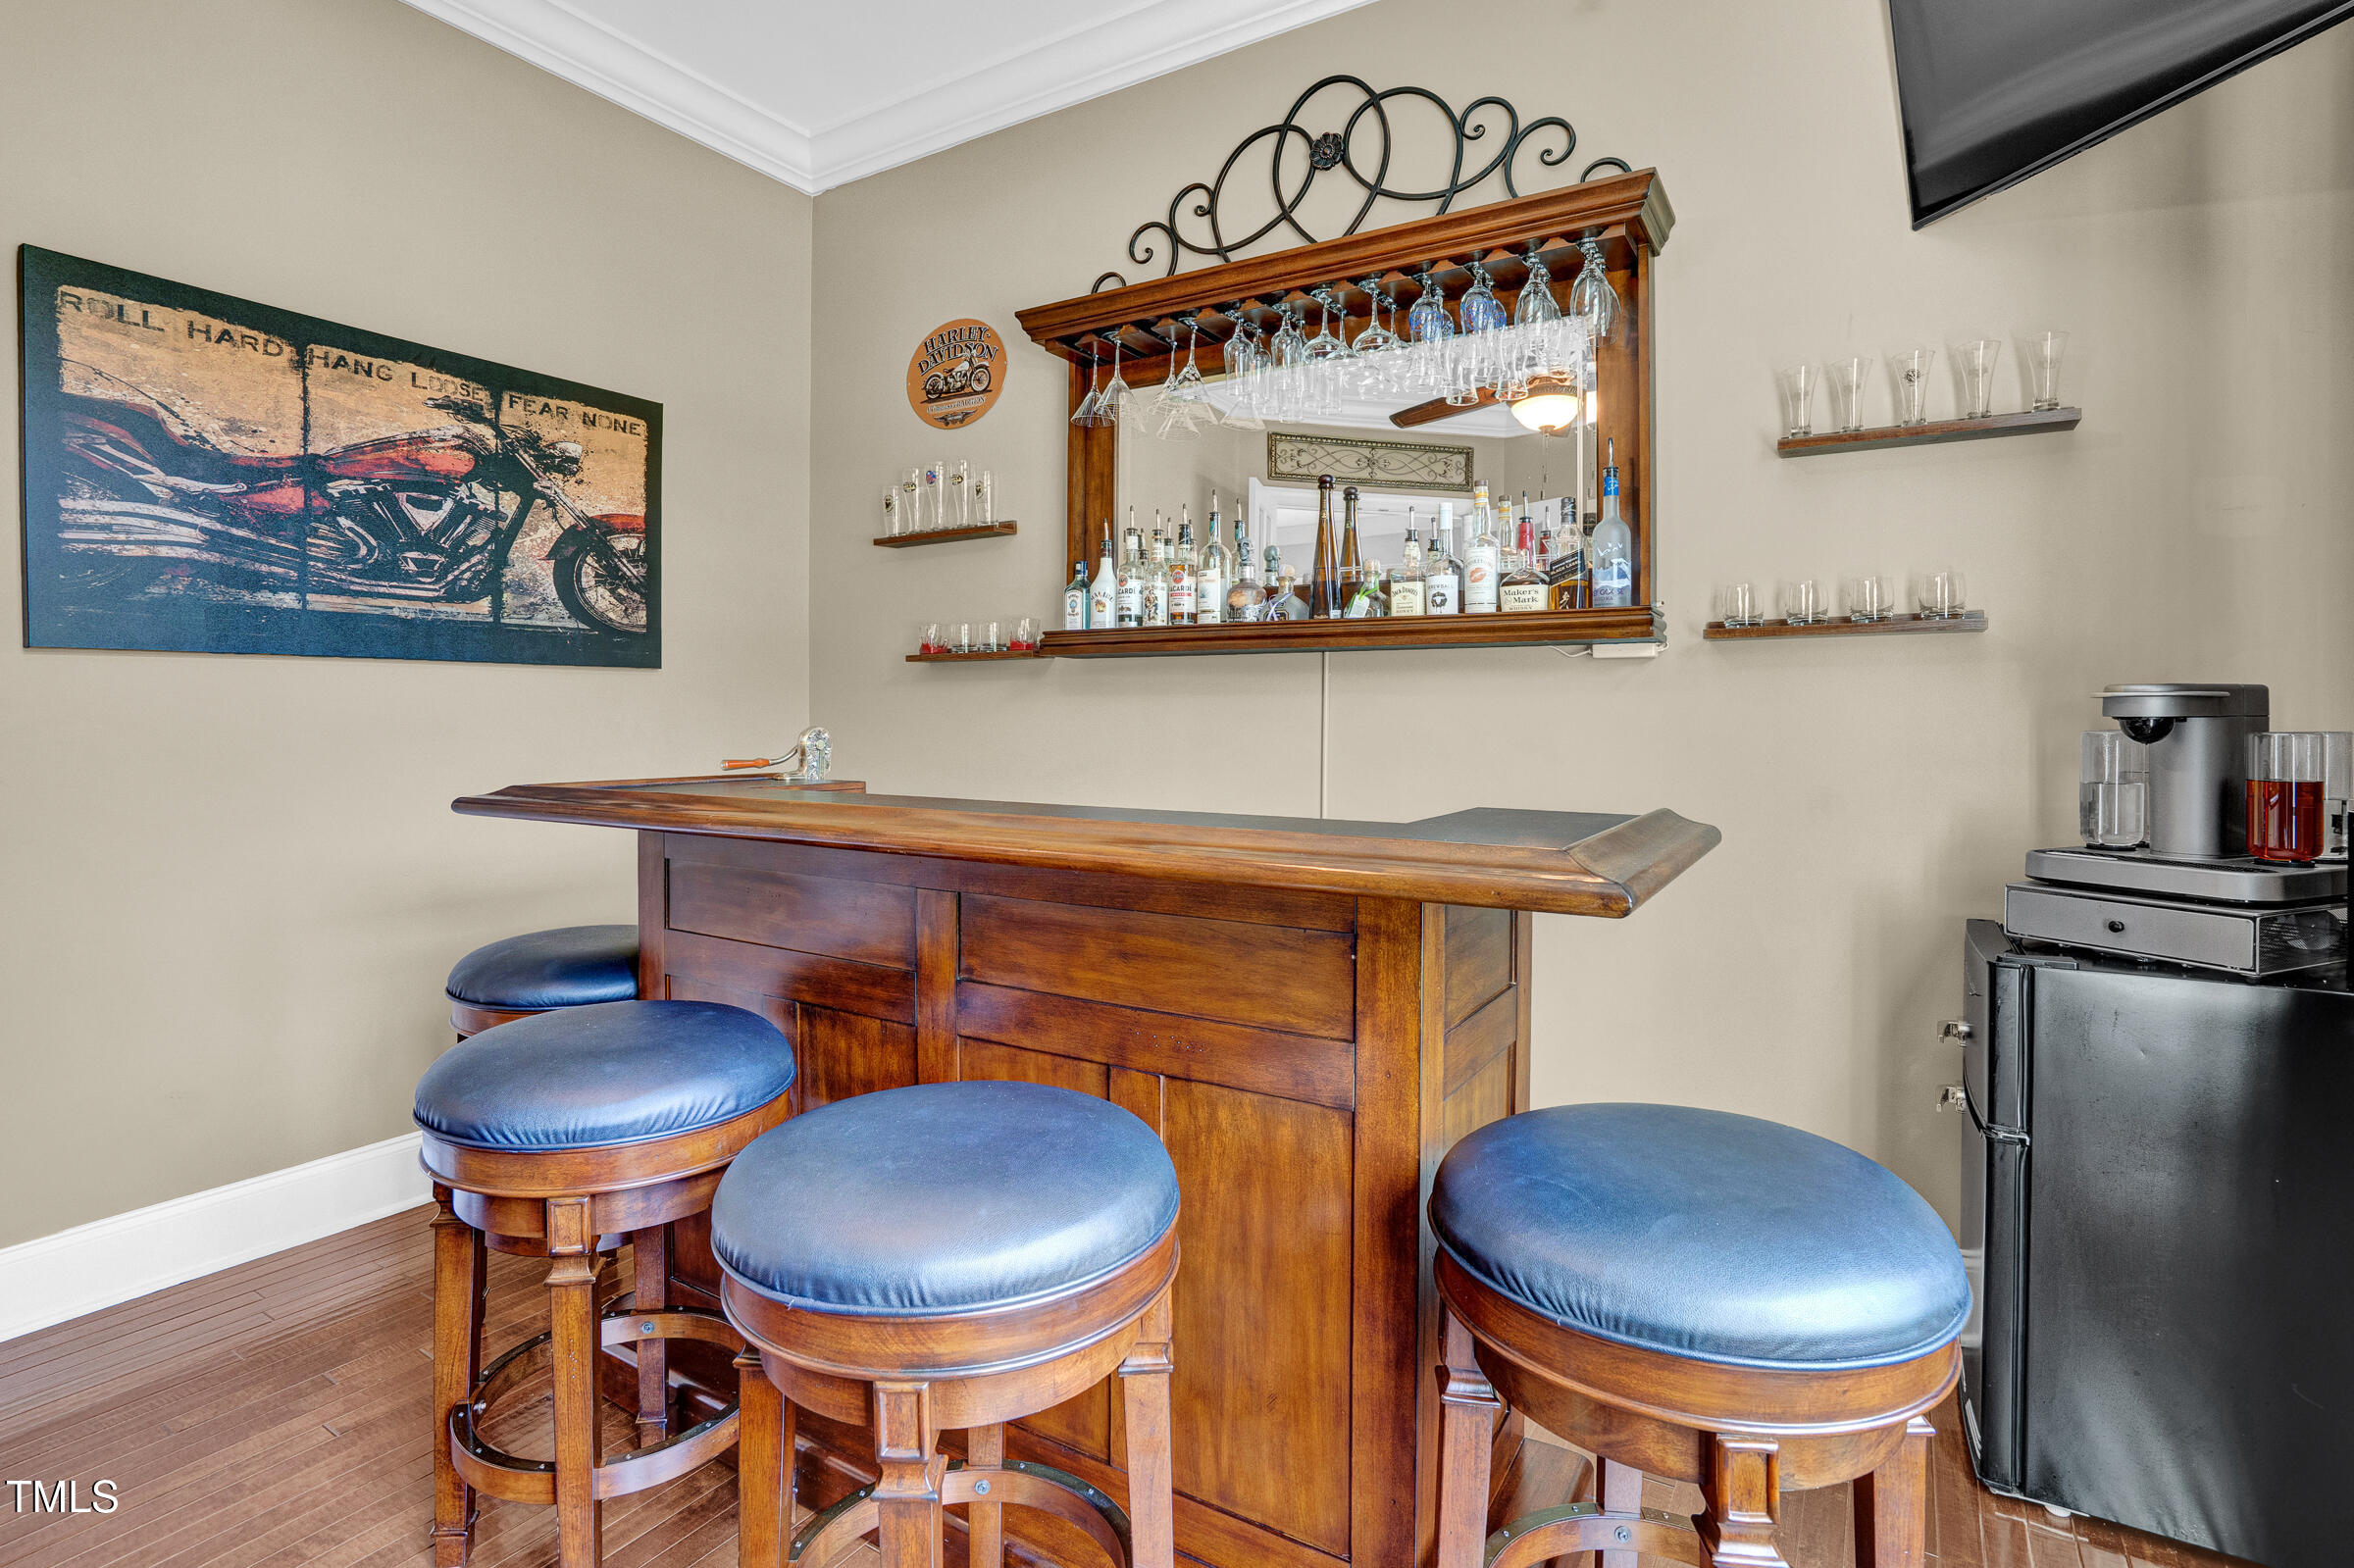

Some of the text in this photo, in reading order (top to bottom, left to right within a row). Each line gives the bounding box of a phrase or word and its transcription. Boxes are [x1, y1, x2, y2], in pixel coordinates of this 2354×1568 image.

[60, 290, 284, 357] ROLL HARD
[306, 347, 486, 402] HANG LOOSE
[918, 341, 998, 376] DAVIDSON
[508, 393, 641, 436] FEAR NONE
[1503, 587, 1540, 597] Maker's
